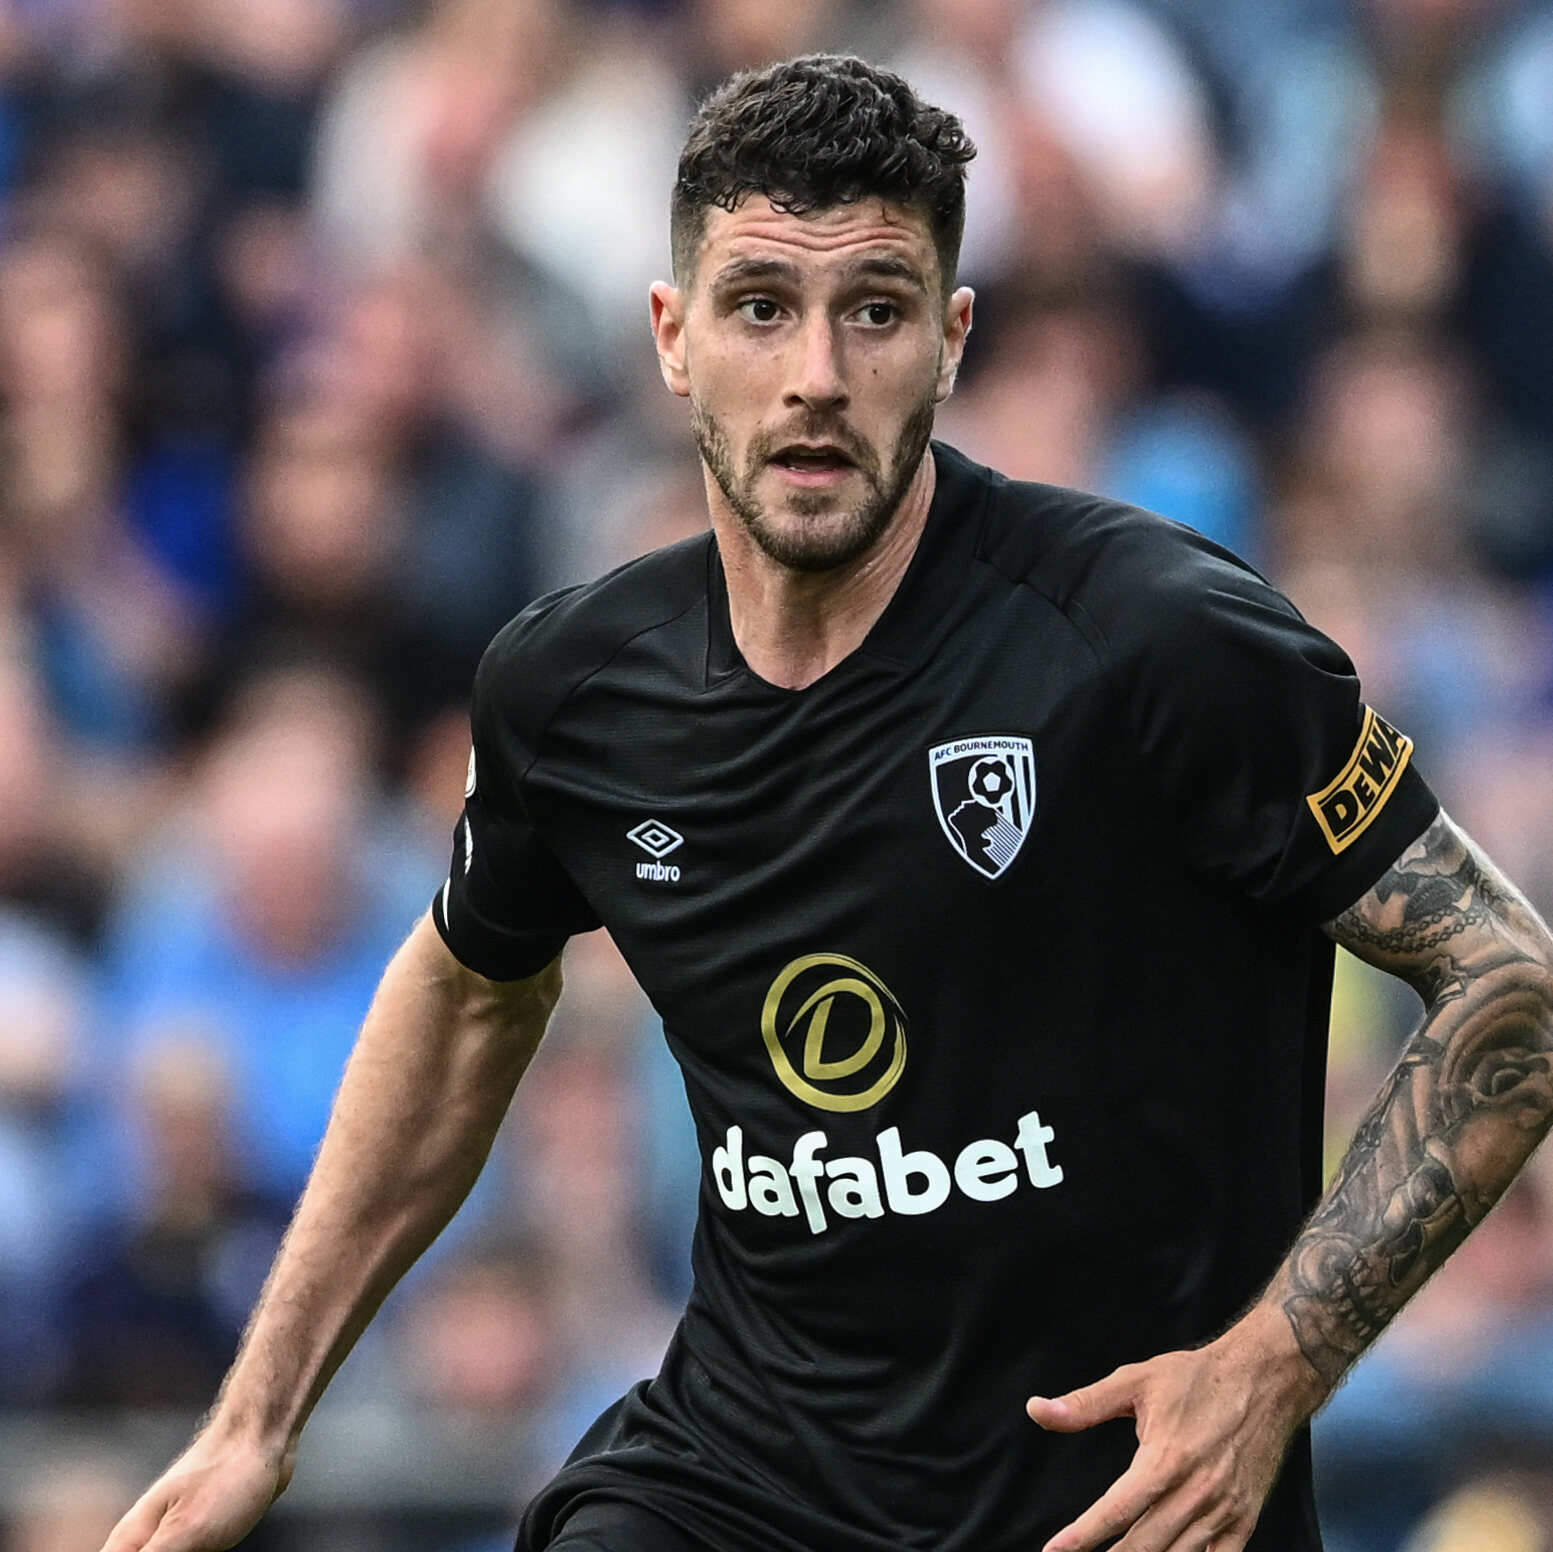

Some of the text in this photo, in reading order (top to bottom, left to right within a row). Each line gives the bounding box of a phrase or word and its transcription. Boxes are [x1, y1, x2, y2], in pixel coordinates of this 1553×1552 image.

[934, 740, 1028, 761] AFC BOURNEMOUTH
[636, 860, 681, 882] umbro
[712, 1110, 1064, 1235] dafabet
